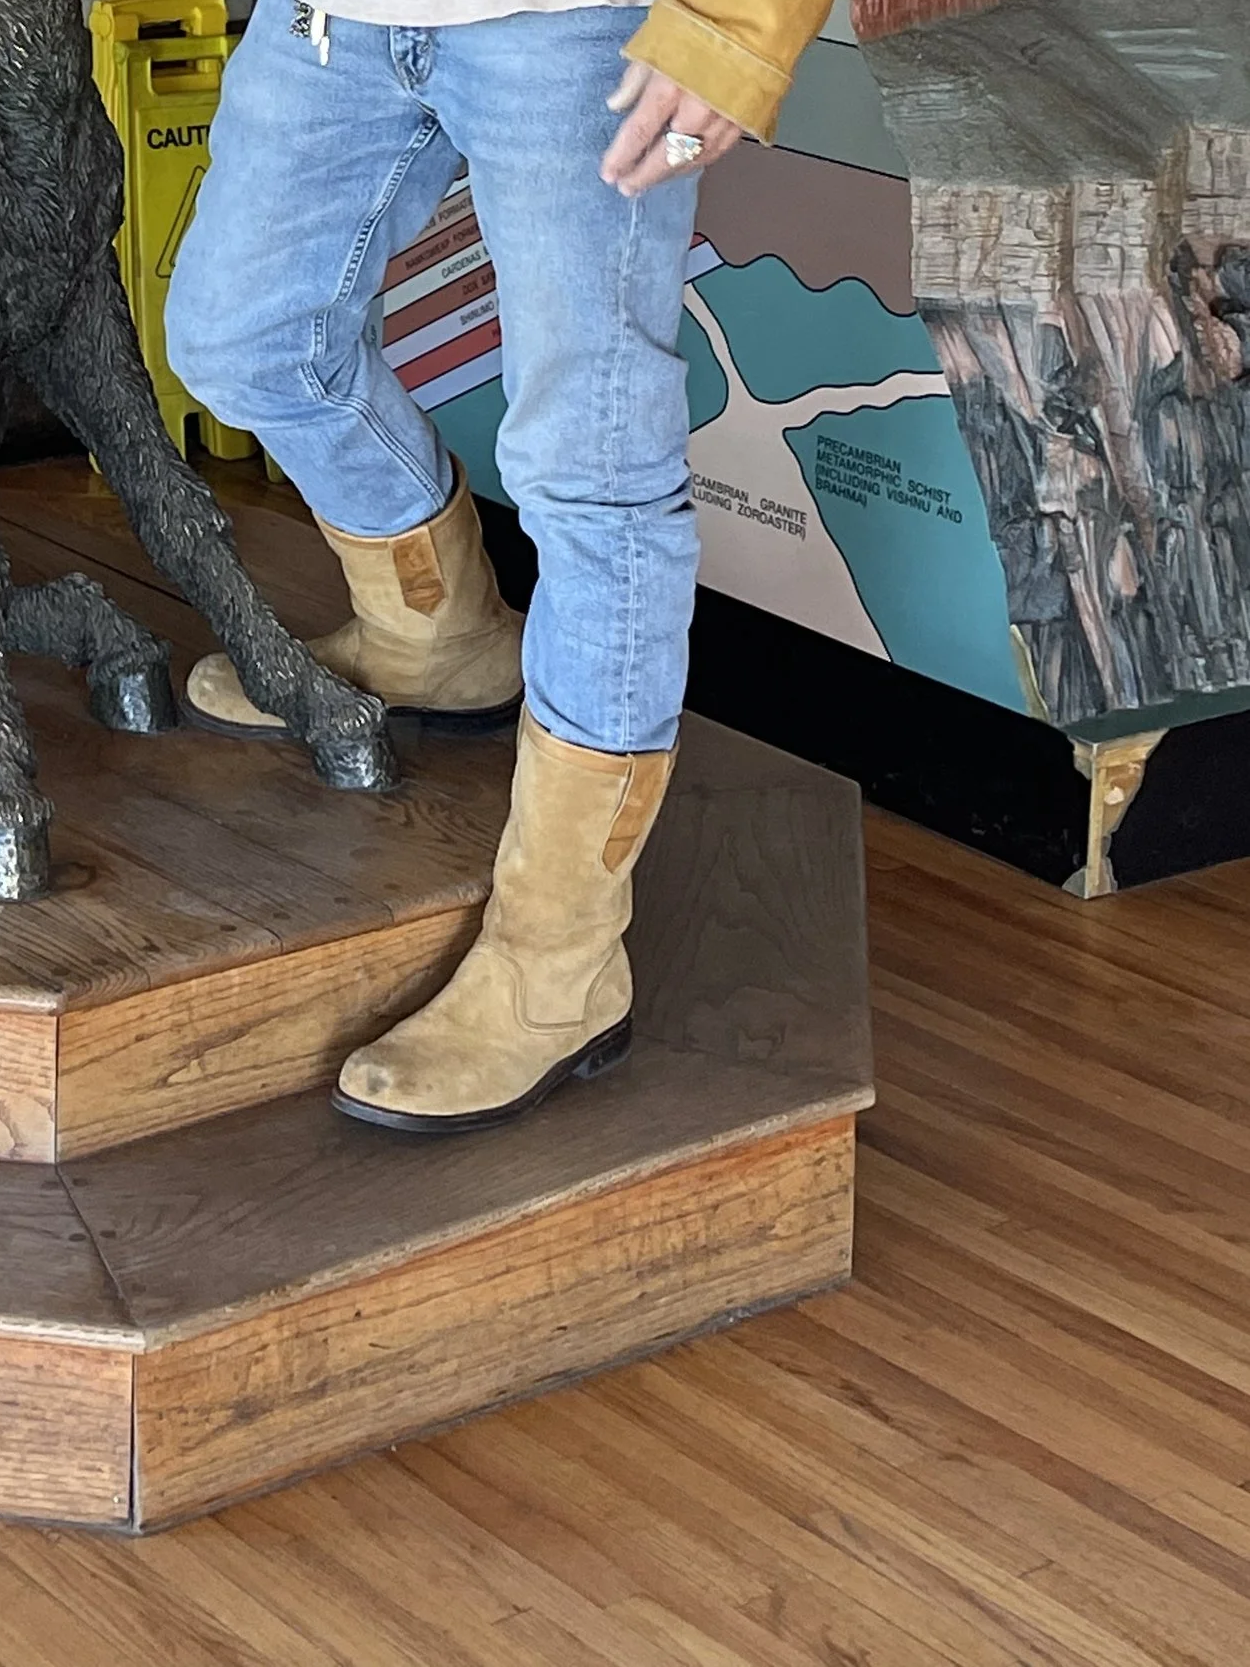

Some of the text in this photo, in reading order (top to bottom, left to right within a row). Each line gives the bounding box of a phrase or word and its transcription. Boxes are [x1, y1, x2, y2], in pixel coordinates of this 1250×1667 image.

[817, 435, 901, 473] PRECAMBRIAN
[815, 464, 963, 524] (INCLUDING VISHNU AND
[816, 449, 952, 504] METAMORPHIC SCHIST
[816, 477, 867, 509] BRAHMA)
[737, 502, 806, 542] ZOROASTER)
[760, 498, 808, 525] GRANITE
